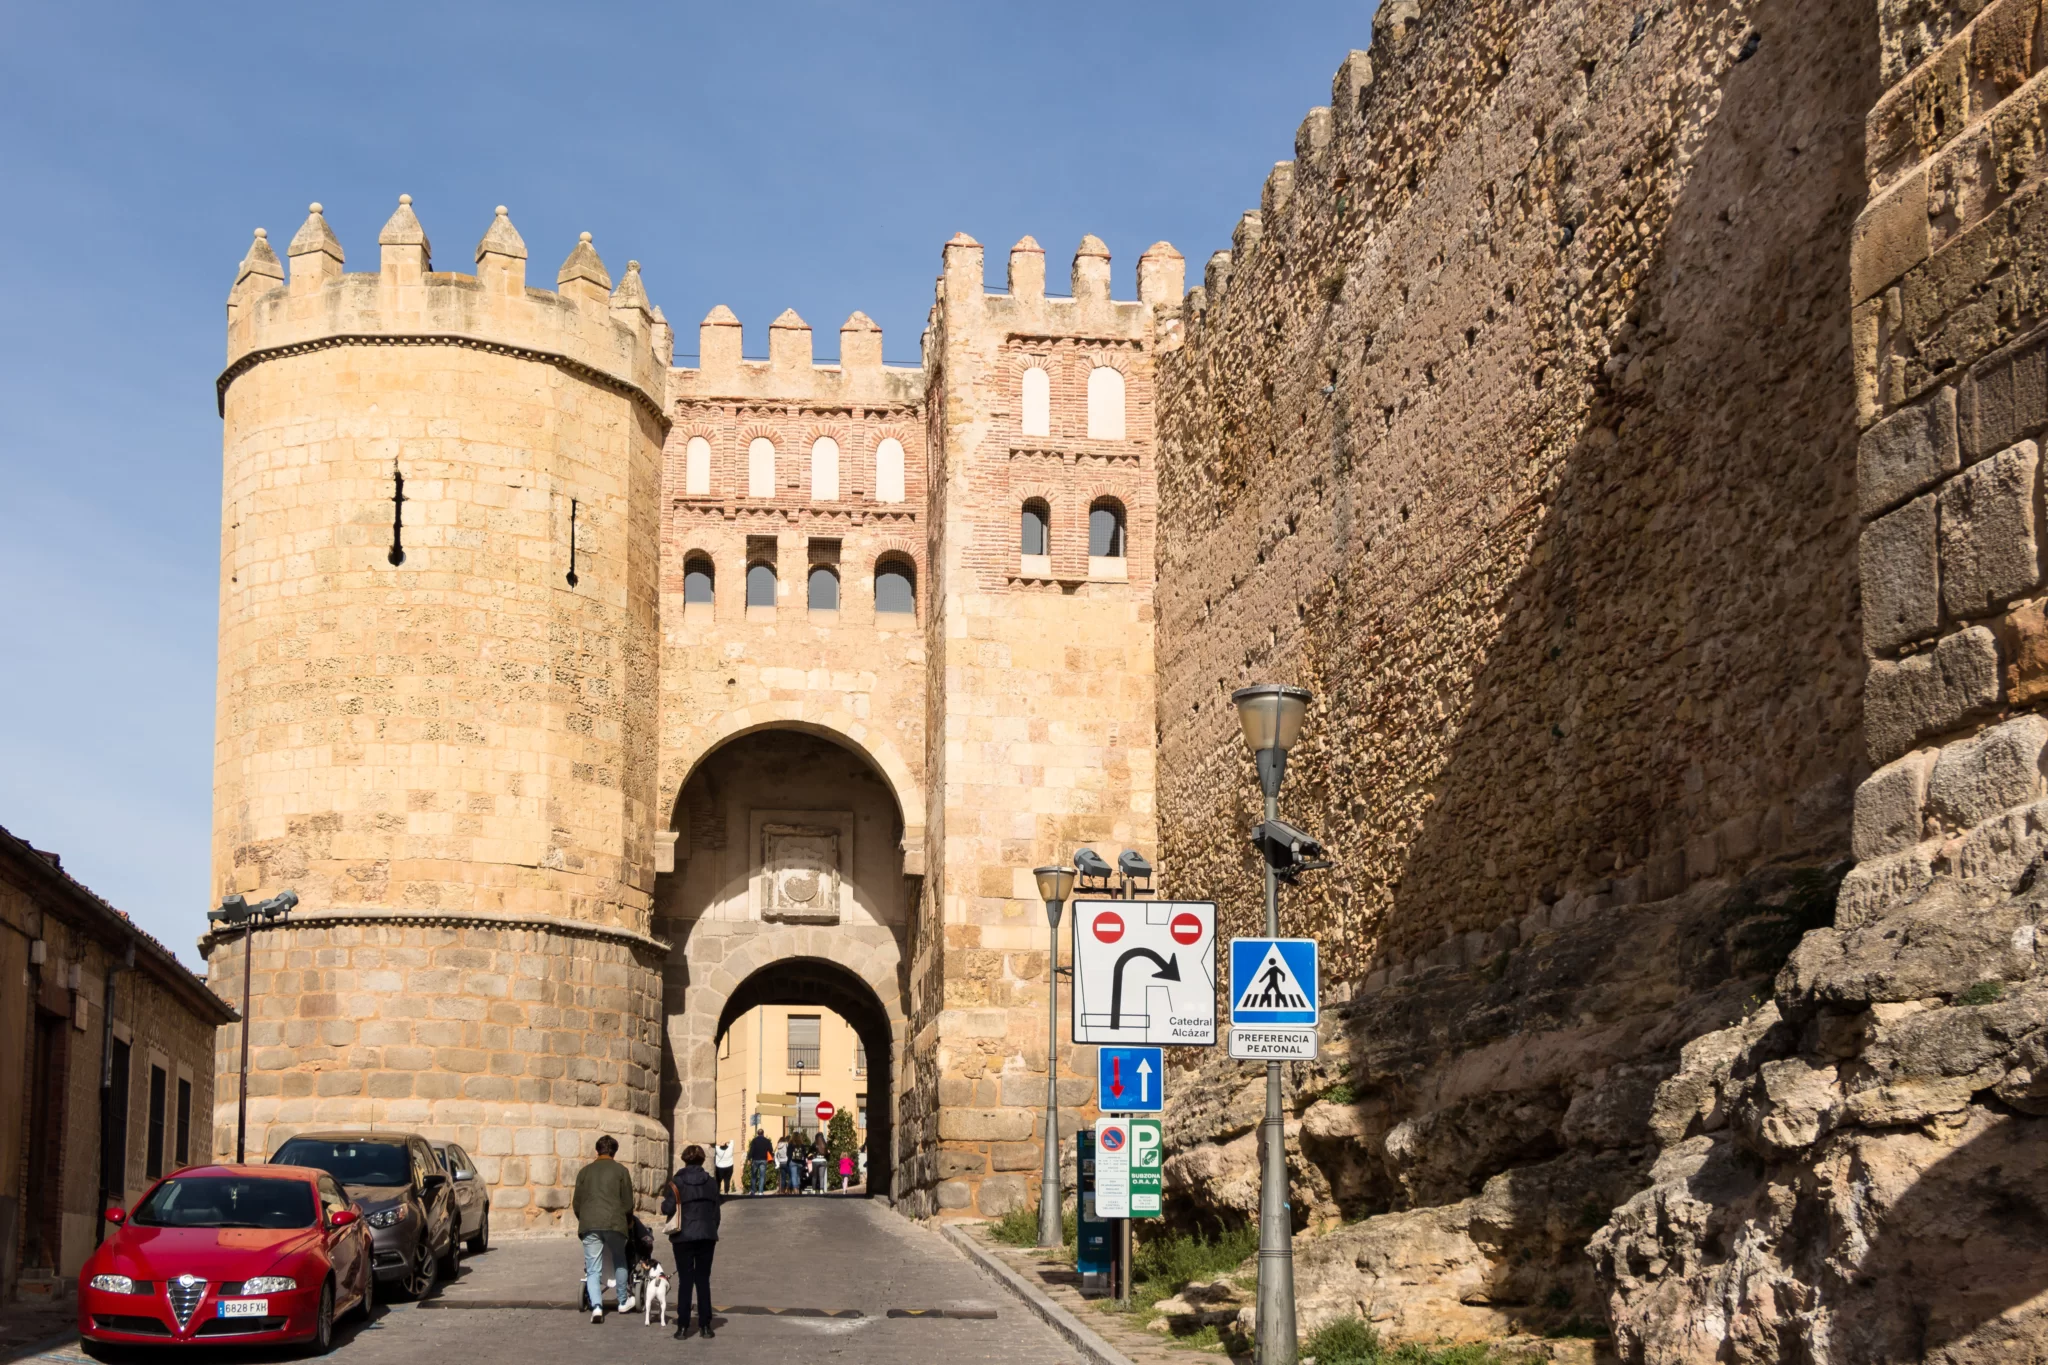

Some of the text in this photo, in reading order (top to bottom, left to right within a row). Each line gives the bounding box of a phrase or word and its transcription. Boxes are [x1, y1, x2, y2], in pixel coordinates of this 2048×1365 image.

[1169, 1016, 1212, 1026] Catedral
[1172, 1028, 1210, 1037] Alcázar
[1238, 1034, 1309, 1043] PREFERENCIA
[1247, 1044, 1302, 1054] PEATONAL
[1131, 1125, 1160, 1168] P
[225, 1302, 267, 1313] 6828 FXH
